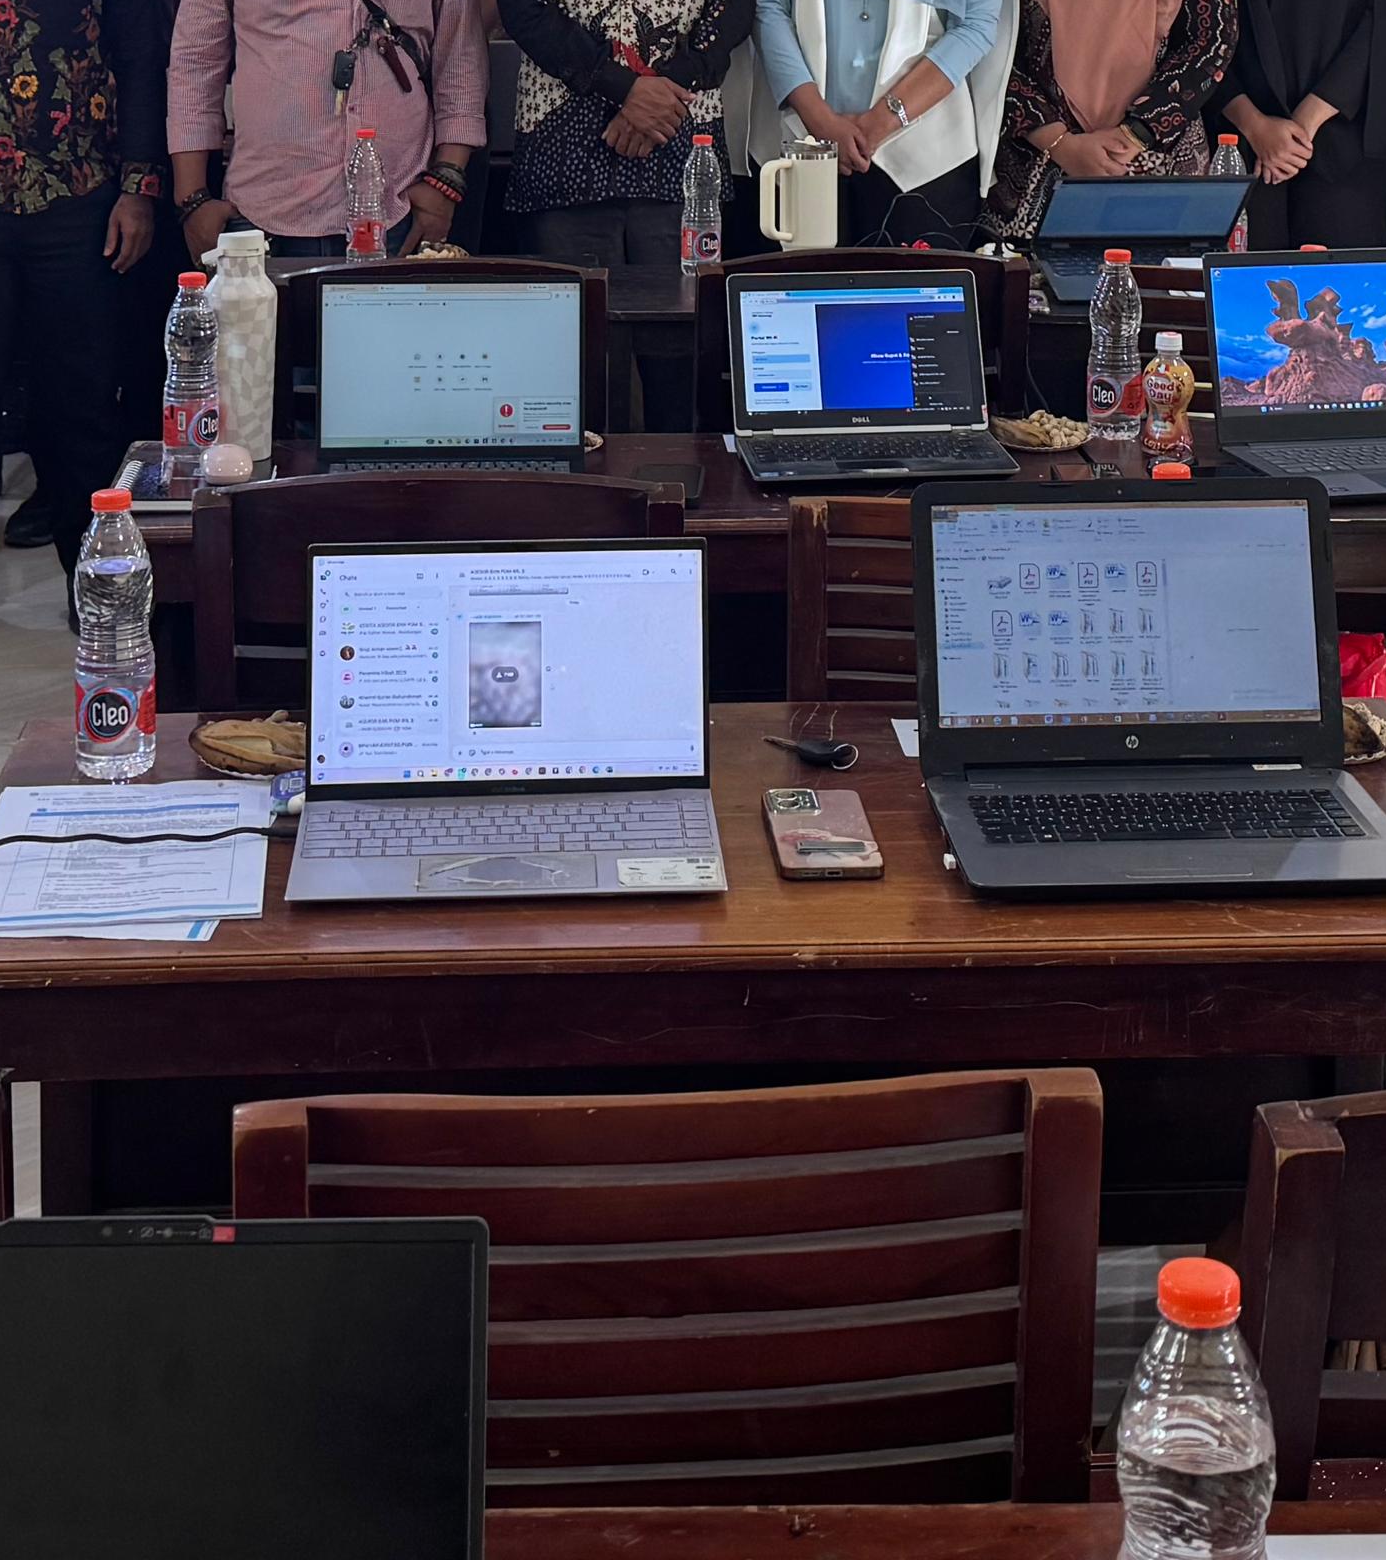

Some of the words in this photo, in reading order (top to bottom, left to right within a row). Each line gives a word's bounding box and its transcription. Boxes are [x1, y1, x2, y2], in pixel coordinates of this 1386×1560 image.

[1147, 378, 1175, 391] Good
[1092, 384, 1116, 404] Cleo
[1149, 389, 1172, 403] Day
[201, 417, 218, 435] Cle
[852, 416, 870, 424] DELL
[92, 701, 130, 728] Cleo
